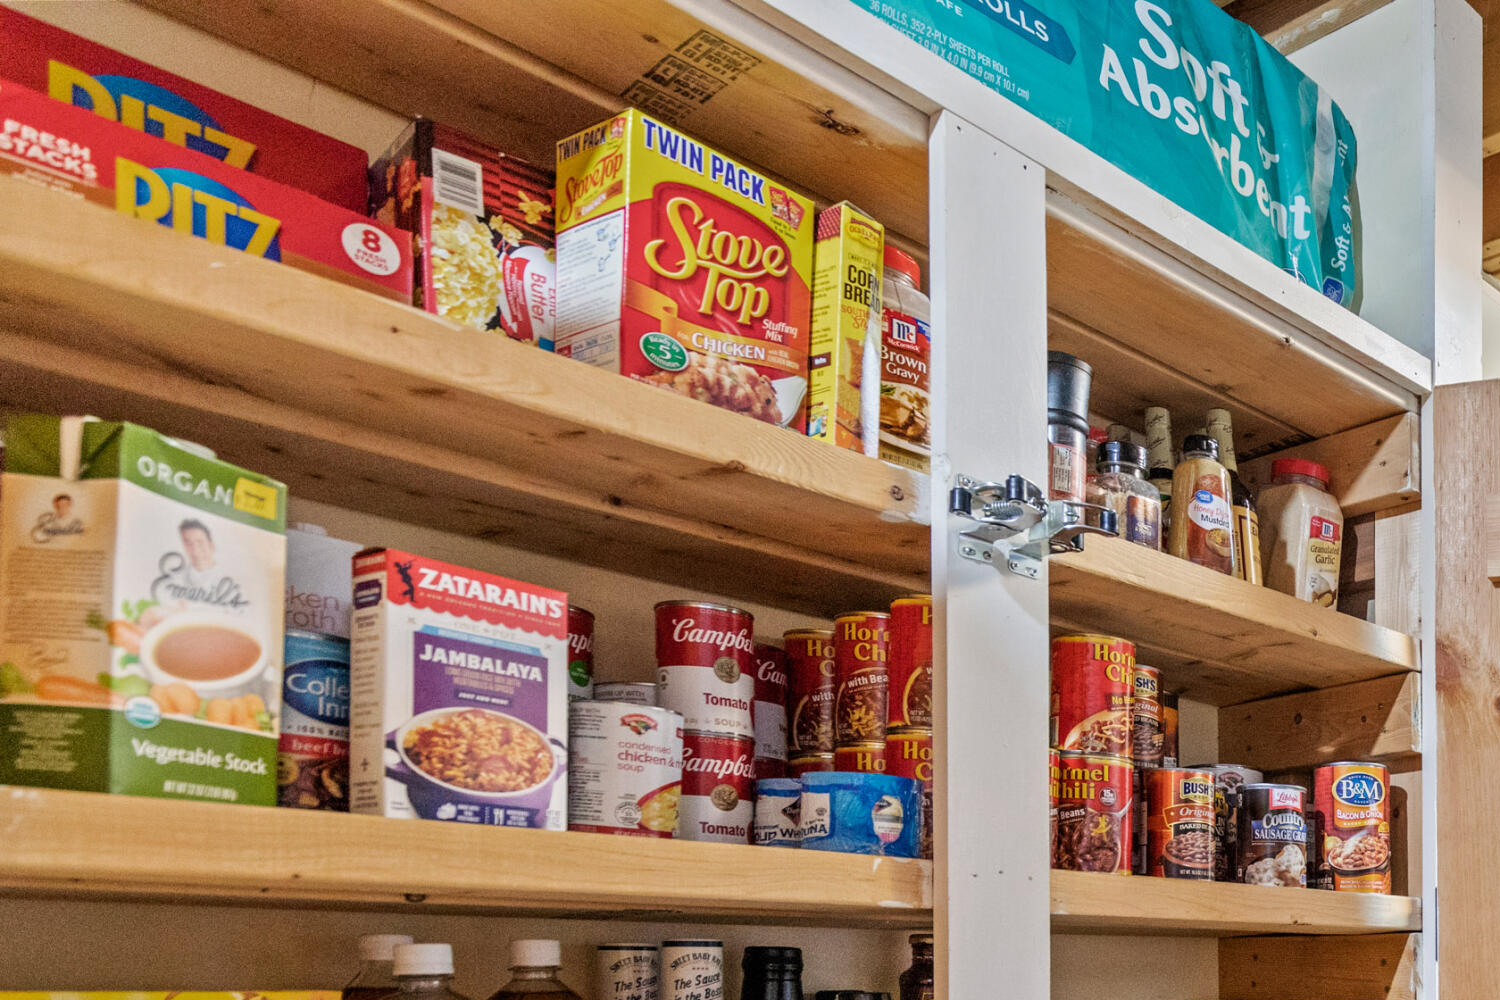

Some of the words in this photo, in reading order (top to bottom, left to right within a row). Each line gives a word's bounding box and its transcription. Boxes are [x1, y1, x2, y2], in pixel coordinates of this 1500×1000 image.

[980, 0, 1049, 42] OLLS
[911, 17, 925, 35] 352
[926, 26, 947, 45] 2-PLY
[949, 36, 976, 60] SHEETS
[978, 53, 991, 69] PER
[992, 60, 1010, 78] ROLL
[1134, 0, 1250, 137] Soft
[4, 118, 91, 162] FRESH
[558, 135, 581, 163] TWIN
[1100, 43, 1312, 241] Absrbent
[0, 132, 98, 179] STACKS
[642, 118, 704, 176] TWIN
[711, 153, 766, 205] PACK
[361, 229, 381, 253] 8
[644, 197, 789, 281] Stove
[1331, 236, 1351, 272] Soft
[847, 264, 880, 289] CORN
[530, 271, 547, 324] Butter
[700, 261, 769, 325] Top
[762, 319, 799, 340] Stuffing
[764, 330, 784, 343] Mix
[658, 345, 672, 360] 5
[691, 331, 766, 361] CHICKEN
[880, 344, 927, 374] Brown
[885, 361, 920, 385] Gravy
[137, 455, 234, 506] ORGAN
[1200, 514, 1230, 529] Mustard
[1315, 554, 1336, 566] Garlic
[417, 566, 564, 619] ZATARAIN'S
[418, 643, 544, 683] JAMBALAYA
[1093, 642, 1136, 668] Horm
[286, 672, 350, 698] Colle
[847, 675, 868, 688] with
[869, 673, 889, 684] Bea
[1135, 676, 1157, 693] SH'S
[702, 692, 748, 712] Tomato
[811, 690, 835, 703] with
[131, 738, 221, 769] Vegetable
[224, 753, 268, 777] Stock
[617, 750, 667, 768] chicken
[617, 761, 645, 775] soup
[1341, 778, 1380, 801] B&M
[1262, 811, 1305, 831] Country
[1336, 809, 1360, 821] BACON
[698, 820, 746, 838] Tomato
[1254, 828, 1292, 842] SAUSAGE
[1293, 829, 1307, 842] GRA
[614, 980, 633, 993] The
[673, 978, 692, 991] The
[695, 972, 721, 987] Sauce
